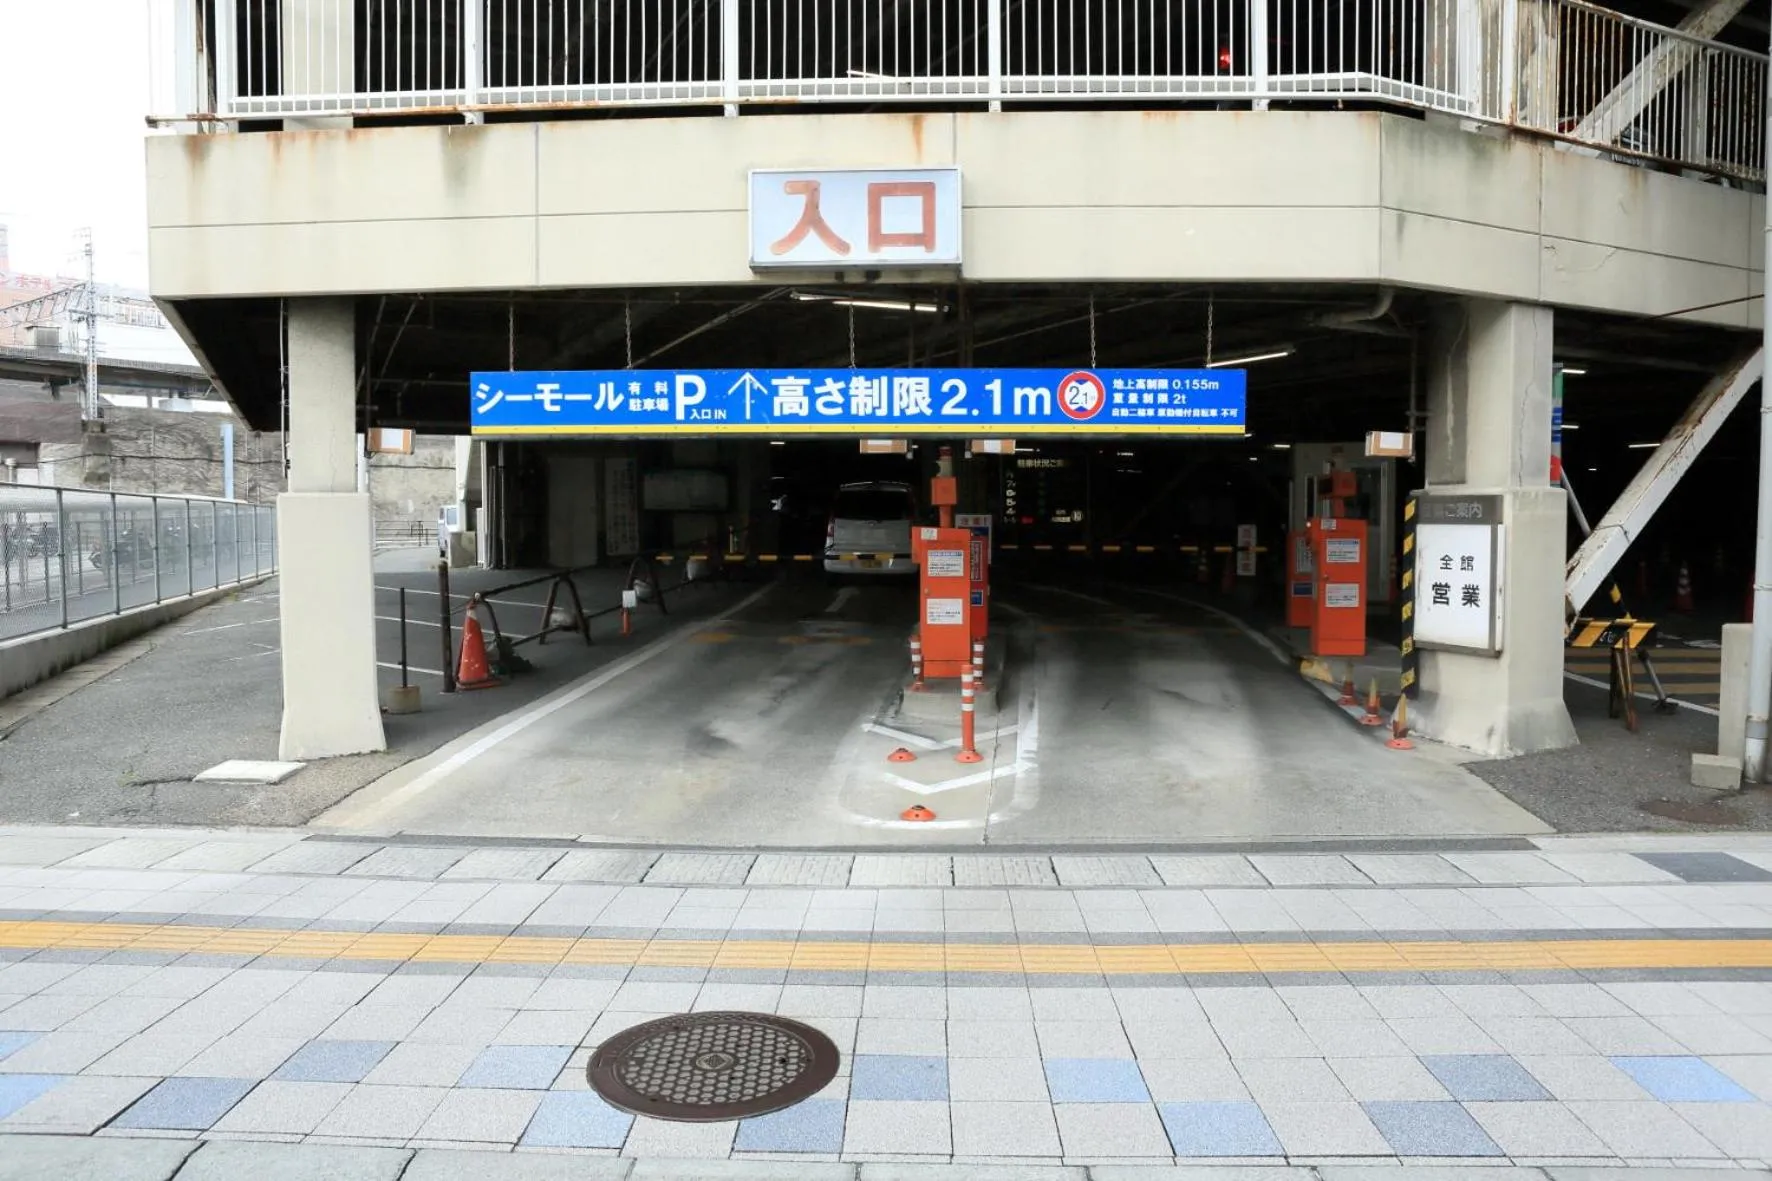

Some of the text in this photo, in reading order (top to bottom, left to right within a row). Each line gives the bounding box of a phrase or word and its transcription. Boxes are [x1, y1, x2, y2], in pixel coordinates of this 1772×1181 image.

[769, 179, 936, 256] 入口
[628, 381, 668, 394] 有料
[1113, 378, 1219, 390] 地上高制限 0.155m
[475, 382, 625, 414] シーモール
[628, 397, 669, 412] 駐車場
[675, 374, 707, 420] P
[771, 376, 1051, 416] 高さ制限 2.1m
[1113, 393, 1187, 404] 重量制限 2t
[690, 408, 727, 420] 入口 IN
[1439, 554, 1475, 572] 全館
[1431, 581, 1481, 608] 営業
